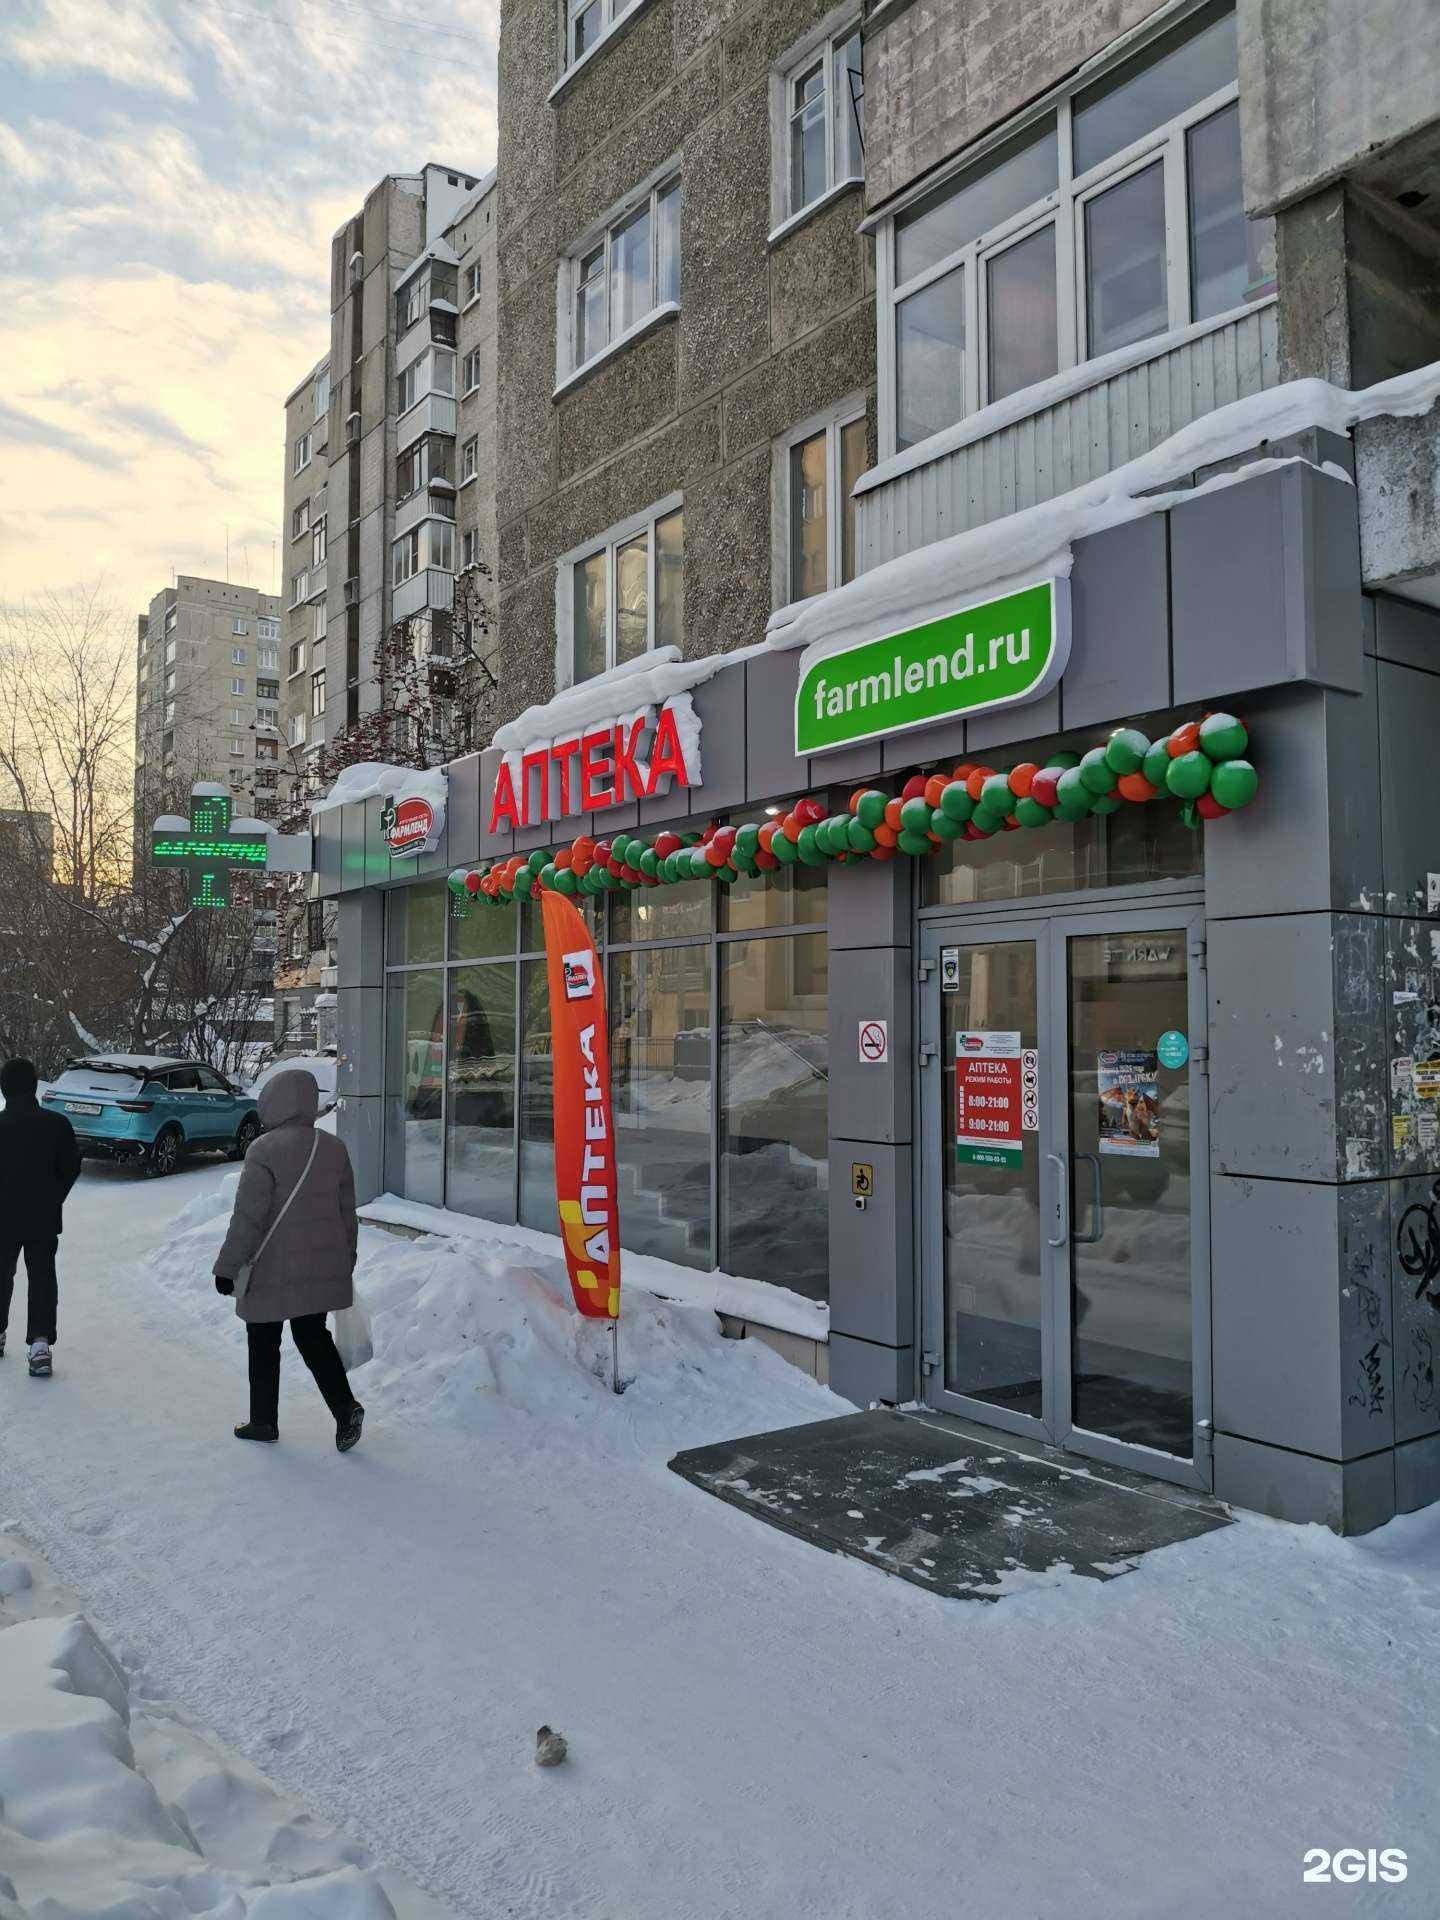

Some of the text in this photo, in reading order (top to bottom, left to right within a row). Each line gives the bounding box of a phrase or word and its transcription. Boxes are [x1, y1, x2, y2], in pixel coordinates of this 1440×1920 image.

[814, 628, 1030, 720] farmlend.ru
[488, 707, 689, 834] АПТЕКА
[390, 818, 428, 839] ФАРМЛЕНД
[968, 1062, 1008, 1074] АПТЕКА
[965, 1075, 1012, 1085] РЕЖИМ РАБОТЫ
[968, 1095, 1009, 1109] 8:00-21:00
[968, 1118, 1010, 1132] 9:00-21:00
[579, 1023, 610, 1265] АПТЕКА
